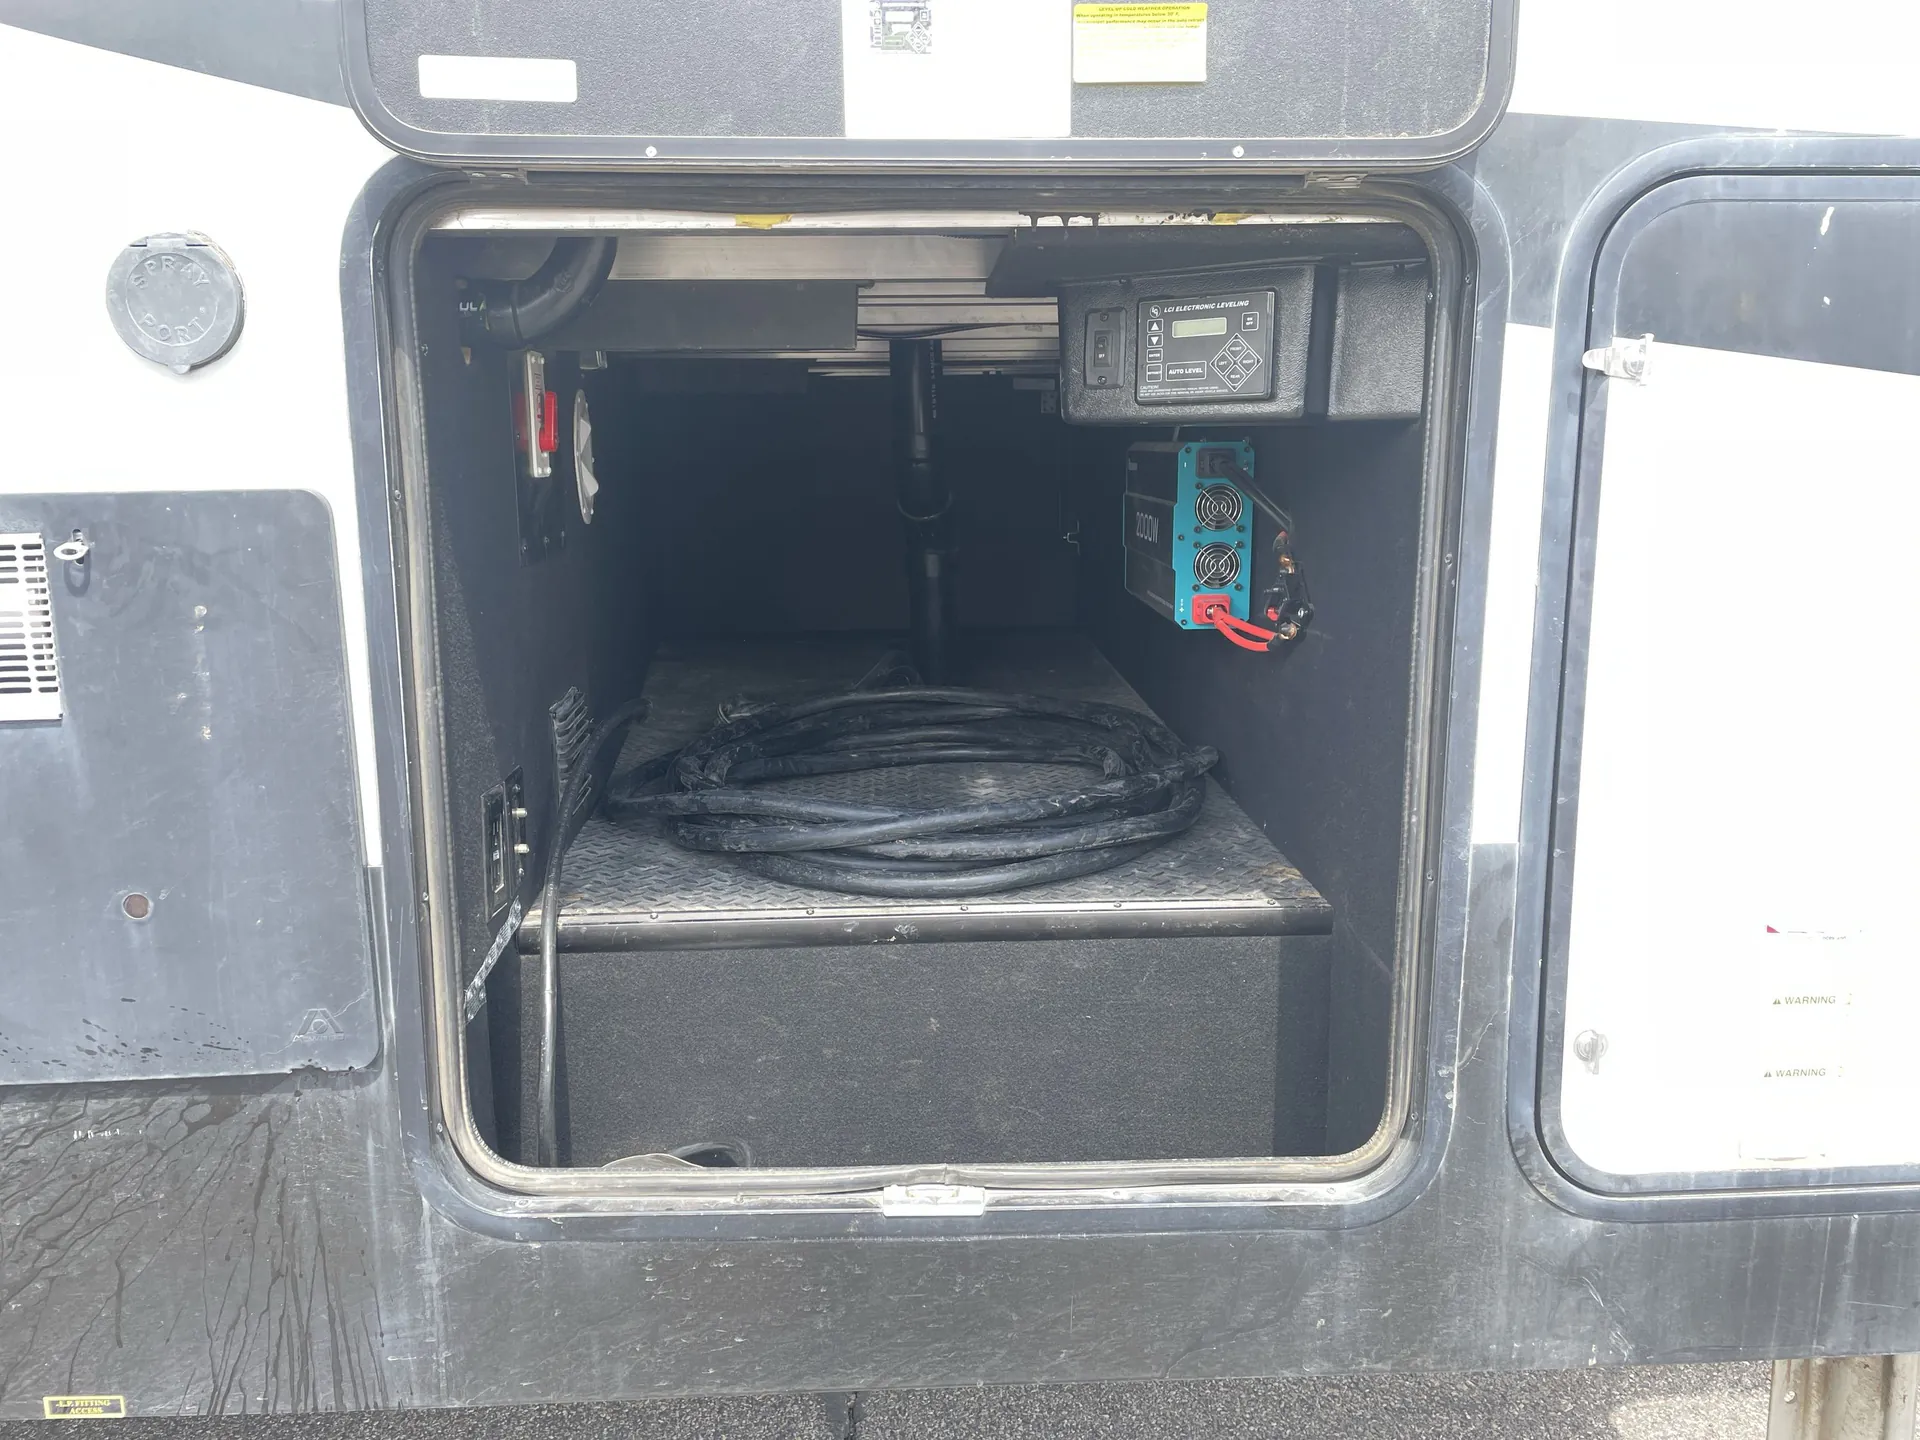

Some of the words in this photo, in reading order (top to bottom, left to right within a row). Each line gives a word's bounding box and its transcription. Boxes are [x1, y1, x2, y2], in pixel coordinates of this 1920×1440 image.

[131, 255, 210, 289] SPRAY
[1175, 303, 1216, 312] ELECTRONIC
[1216, 300, 1249, 309] LEVELING
[138, 313, 204, 343] PORT
[1136, 511, 1159, 543] 2000W
[1784, 996, 1836, 1005] WARNING
[1775, 1068, 1826, 1078] WARNING
[75, 1399, 111, 1407] FITTING
